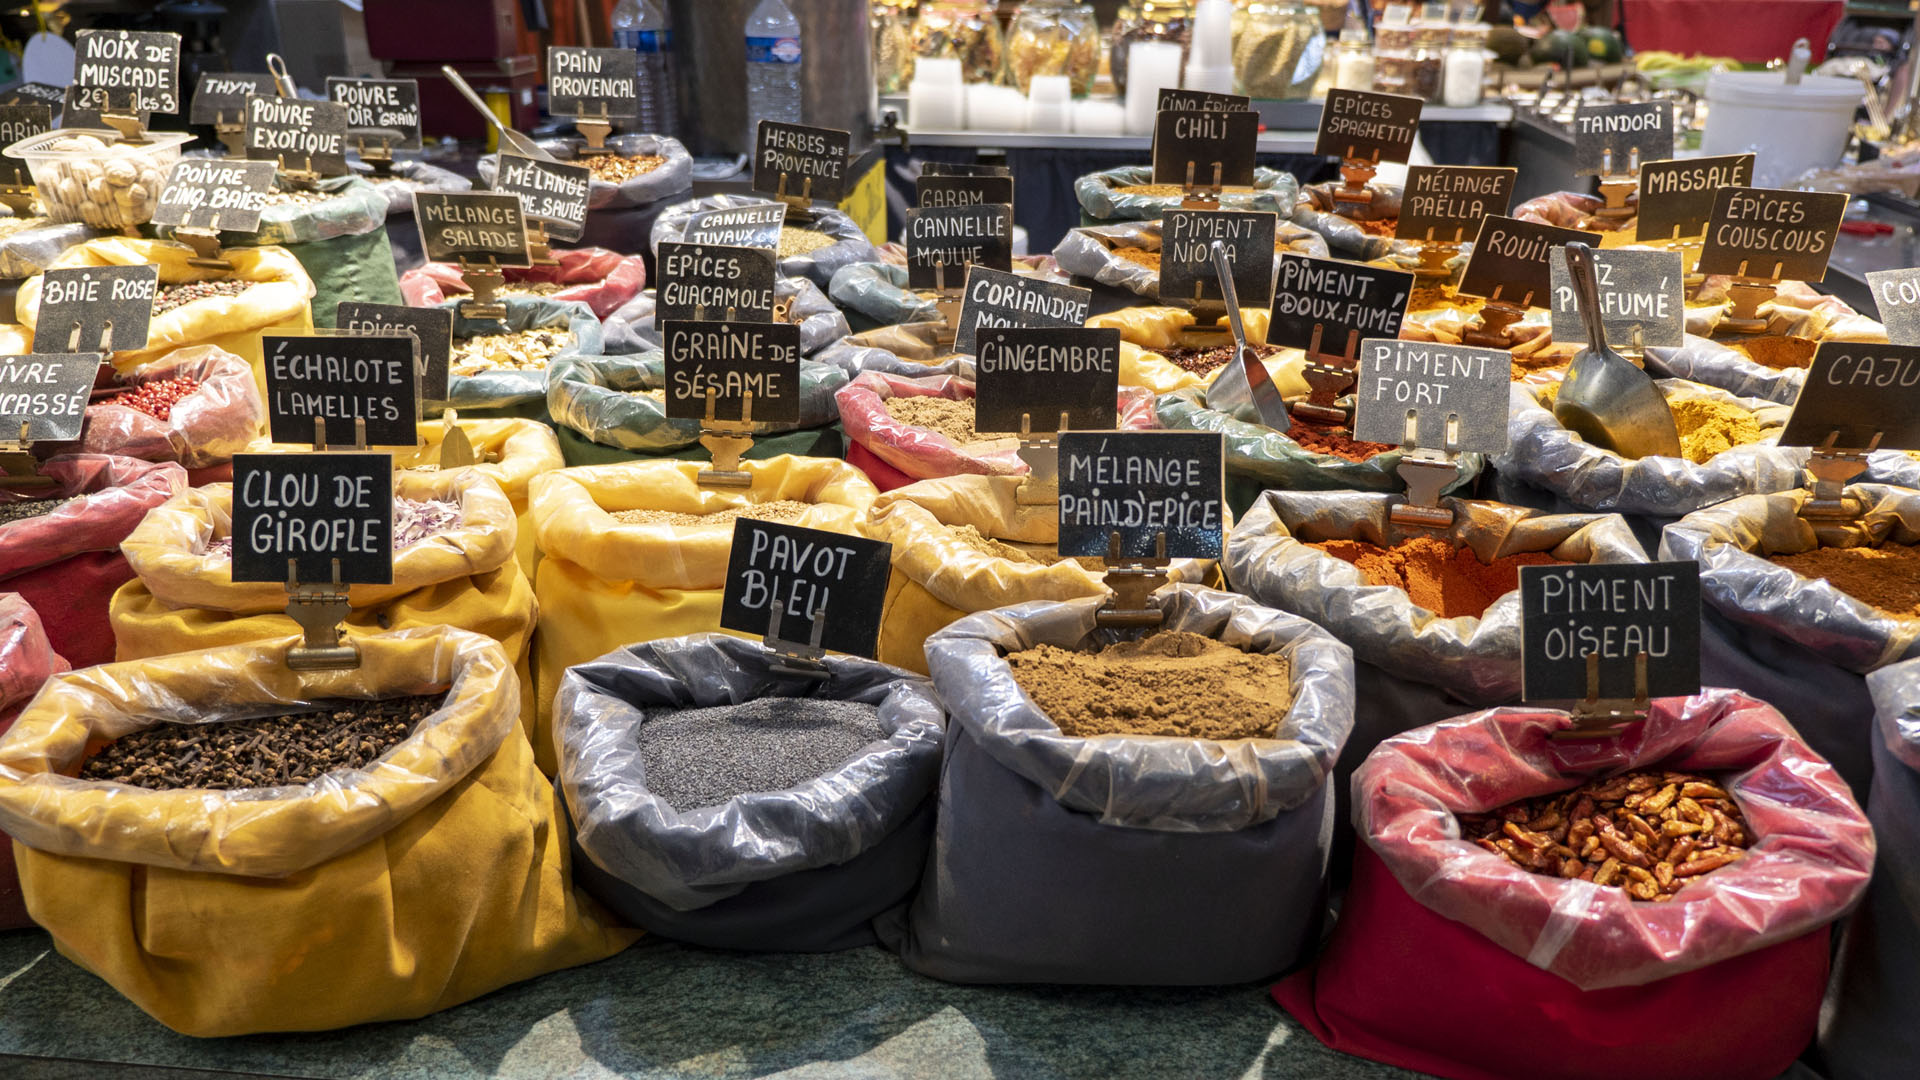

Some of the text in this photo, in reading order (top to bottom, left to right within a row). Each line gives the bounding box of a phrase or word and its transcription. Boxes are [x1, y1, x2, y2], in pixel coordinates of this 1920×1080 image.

[145, 46, 172, 62] DE
[81, 64, 169, 88] MUSCADE
[205, 79, 256, 95] THYM
[552, 76, 636, 98] PROVENCAL
[135, 88, 159, 110] les
[161, 93, 176, 112] 3
[764, 149, 841, 179] PROVENCE
[1648, 155, 1748, 194] MASSALÉ
[506, 160, 588, 197] MÉLANGE
[1416, 169, 1504, 195] MÉLANGE
[426, 195, 517, 224] MÉLANGE
[701, 210, 782, 228] CANNELLE
[1410, 194, 1484, 219] PAËLLA
[442, 228, 519, 248] SALADE
[913, 216, 1006, 239] CANNELLE
[1715, 223, 1827, 254] COUSCOUS
[111, 279, 156, 300] ROSE
[664, 282, 773, 310] GUACAMOLE
[1554, 276, 1670, 318] PFUMÉ
[273, 341, 403, 385] ÉCHALOTE
[769, 343, 797, 364] DE
[673, 364, 782, 401] SÉSAME
[1376, 377, 1450, 405] FORT
[0, 385, 87, 415] CASSÉ
[276, 392, 400, 421] LAMELLES
[1069, 438, 1201, 487] MÉLANGE
[243, 470, 372, 511] CLOU DE
[750, 528, 856, 581] PAVOT
[740, 569, 830, 622] BLEU
